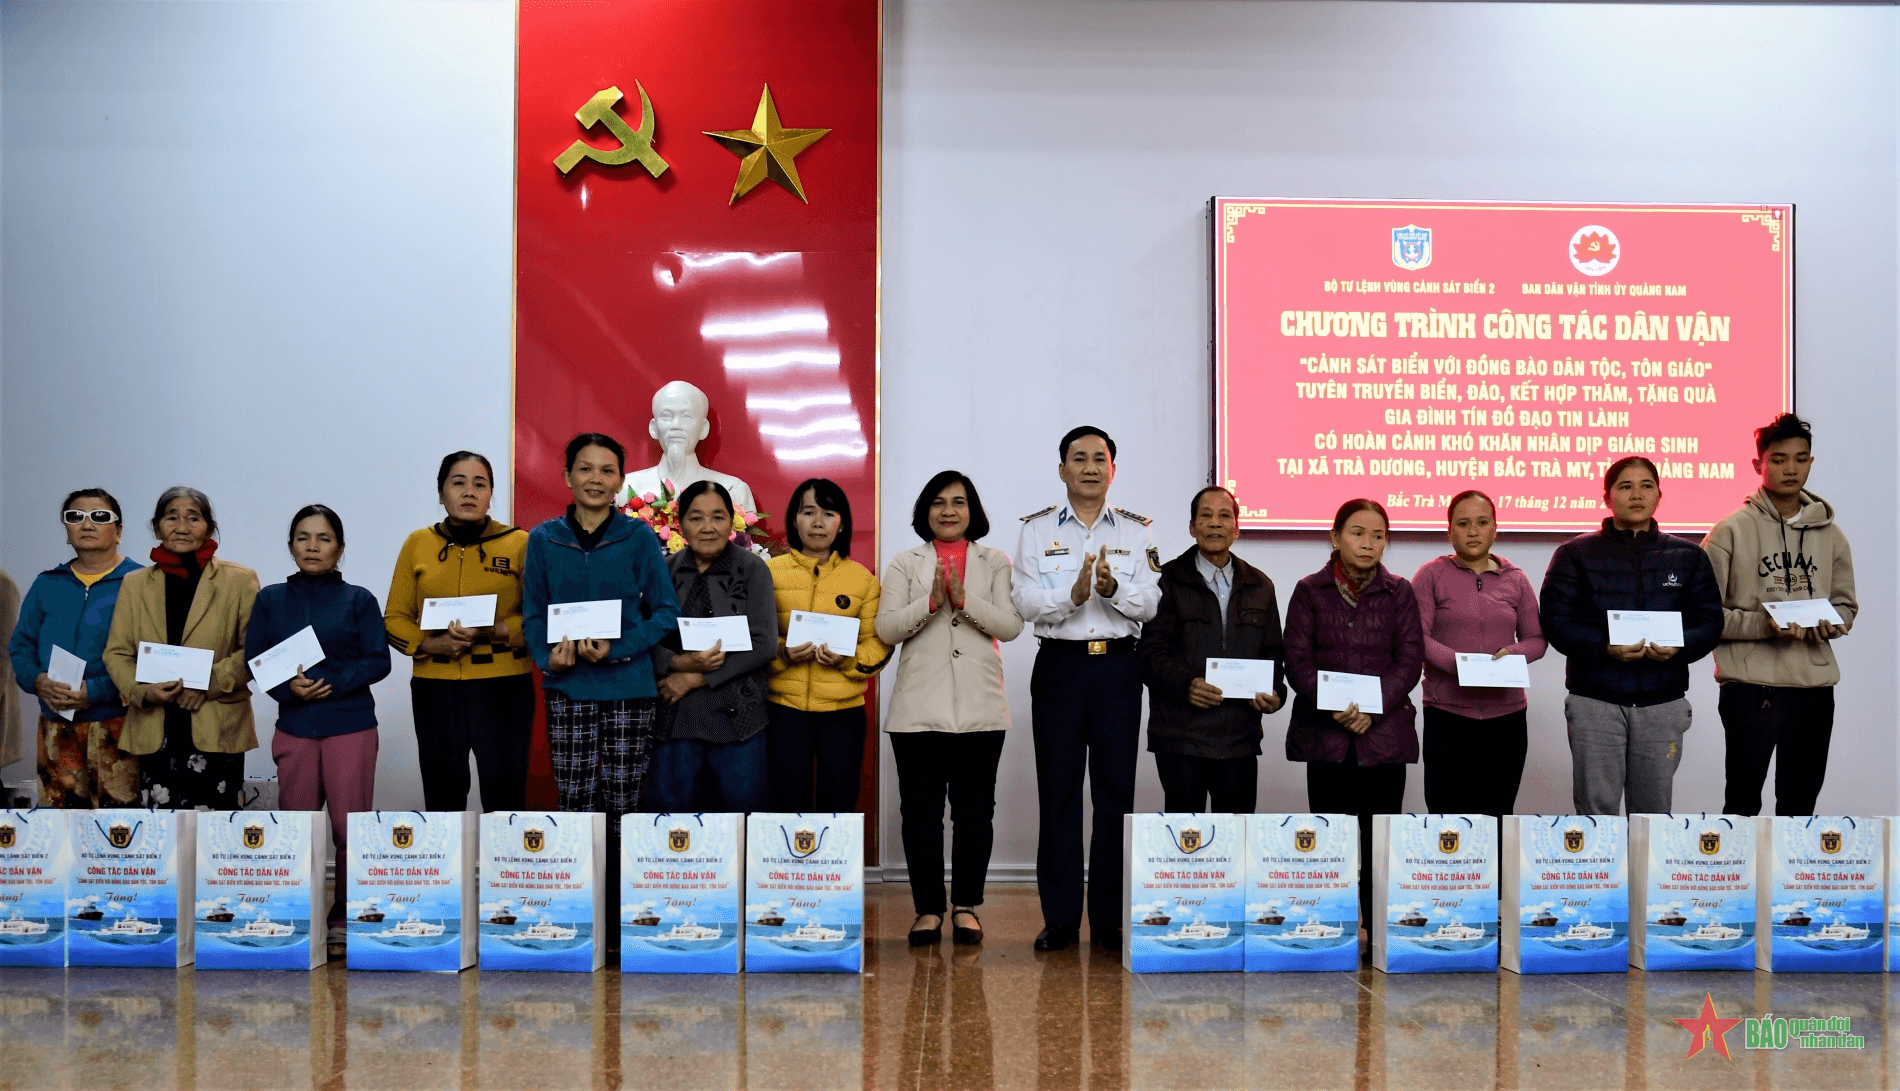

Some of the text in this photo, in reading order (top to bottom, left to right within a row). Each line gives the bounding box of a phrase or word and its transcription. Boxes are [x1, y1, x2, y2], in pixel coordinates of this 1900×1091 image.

[1324, 278, 1495, 294] BỘ TƯ LỆNH VÙNG CẢNH SÁT BIỂN 2
[1522, 281, 1686, 297] BAN DÂN VẬN TỈNH ỦY QUẢNG NAM
[1281, 307, 1730, 346] CHƯƠNG TRÌNH CÔNG TÁC DÂN VẬN
[1300, 353, 1712, 380] "CẢNH SÁT BIỂN VỚI ĐỒNG BÀO DÂN TỘC, TÔN GIÁO"
[1296, 378, 1716, 405] TUYÊN TRUYỀN BIỂN, ĐẢO, KẾT HỢP THĂM, TẶNG QUÀ
[1385, 405, 1629, 430] GIA ĐÌNH TÍN ĐỒ ĐẠO TIN LÀNH
[1315, 430, 1698, 456] CÓ HOÀN CẢNH KHÓ KHĂN NHÂN DỊP GIÁNG SINH
[1277, 458, 1303, 478] TẠI
[1308, 455, 1329, 475] XÃ
[1333, 455, 1365, 475] TRÀ
[1370, 457, 1431, 478] DƯƠNG,
[1436, 457, 1488, 480] HUYỆN
[1494, 455, 1526, 477] BẮC
[1531, 458, 1562, 477] TRÀ
[1567, 462, 1594, 480] MY,
[1699, 463, 1734, 479] NAM
[1386, 491, 1410, 507] Bắc
[1413, 495, 1434, 507] Trà
[1498, 496, 1511, 509] 17
[1514, 495, 1550, 512] tháng
[1553, 496, 1567, 509] 12
[1569, 496, 1597, 509] năm
